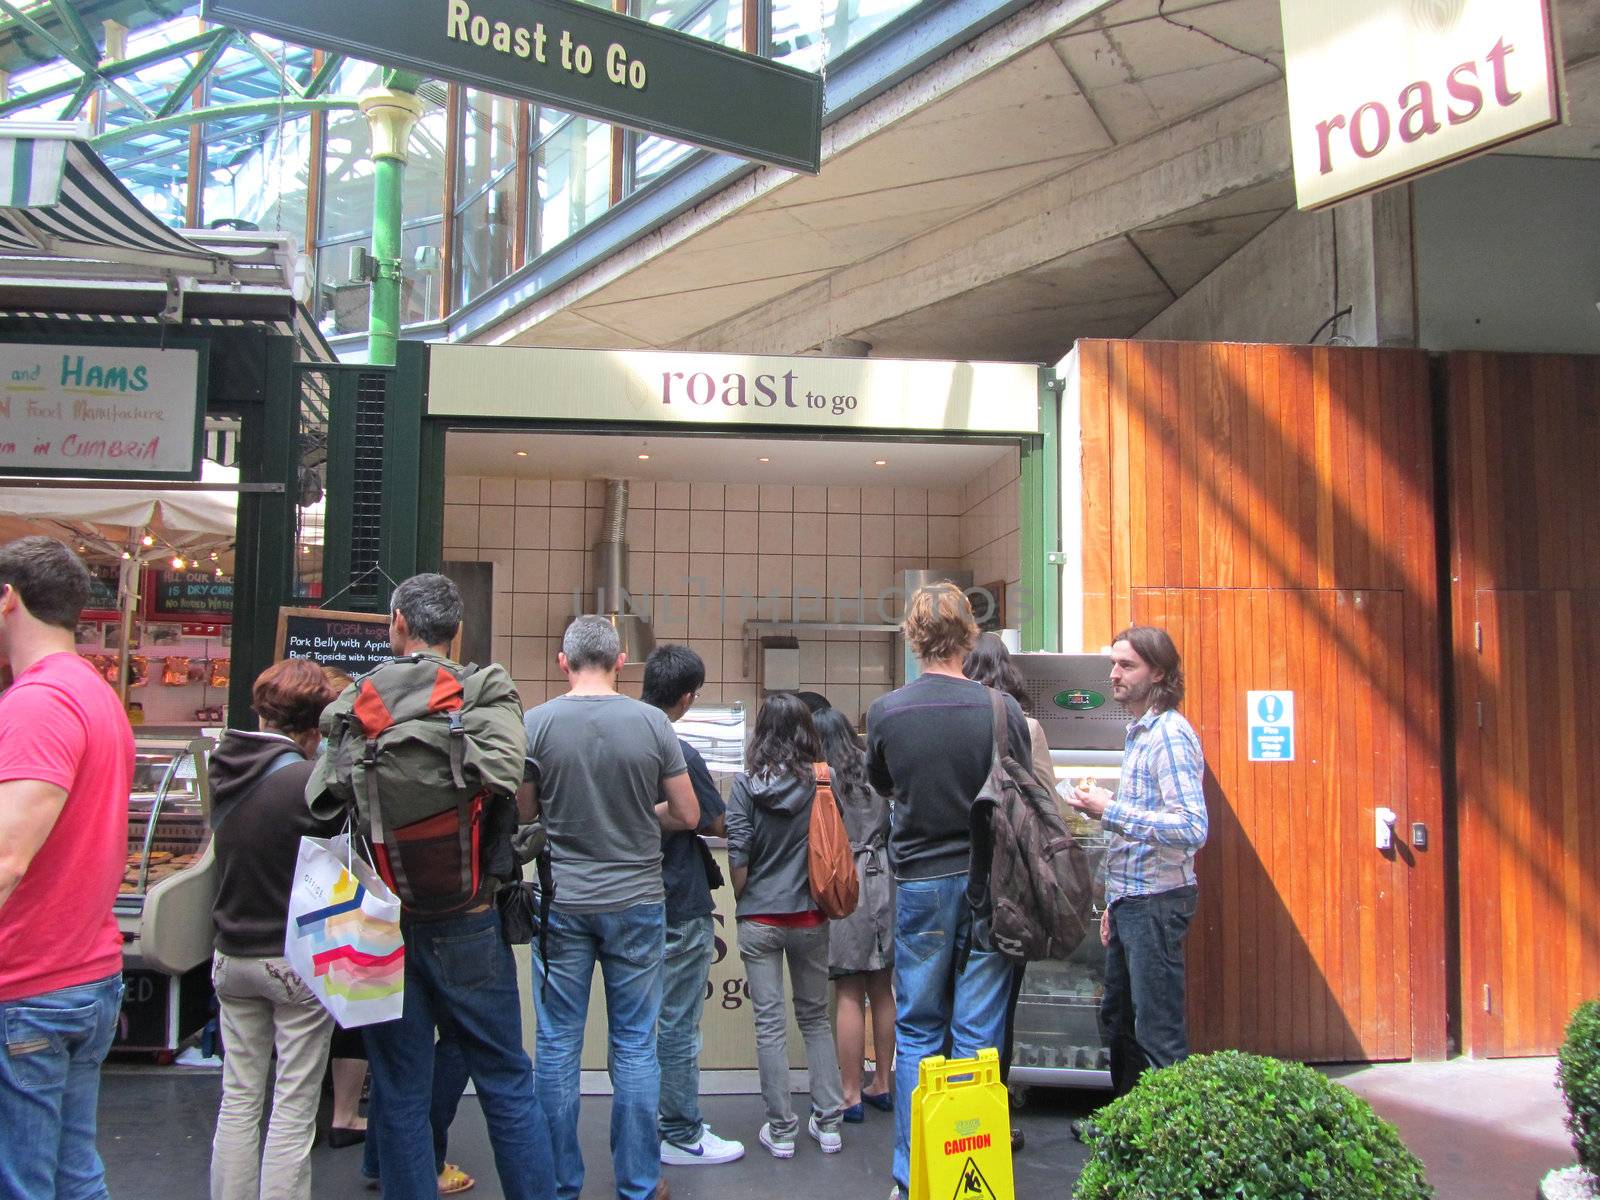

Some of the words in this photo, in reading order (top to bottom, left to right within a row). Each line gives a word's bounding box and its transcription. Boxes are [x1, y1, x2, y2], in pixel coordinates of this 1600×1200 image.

[447, 0, 547, 63] Roast
[560, 30, 593, 74] to
[606, 43, 647, 89] Go
[1315, 35, 1523, 176] roast
[11, 364, 41, 382] and
[60, 354, 149, 392] HAMS
[662, 369, 799, 408] roast
[805, 391, 827, 409] to
[831, 395, 858, 416] go
[290, 636, 311, 647] Pork
[314, 636, 339, 651] Belly
[341, 638, 360, 648] with
[326, 622, 362, 635] roast
[289, 650, 312, 660] Beef
[314, 651, 346, 663] Topside
[349, 653, 365, 661] with
[944, 1133, 991, 1156] CAUTION
